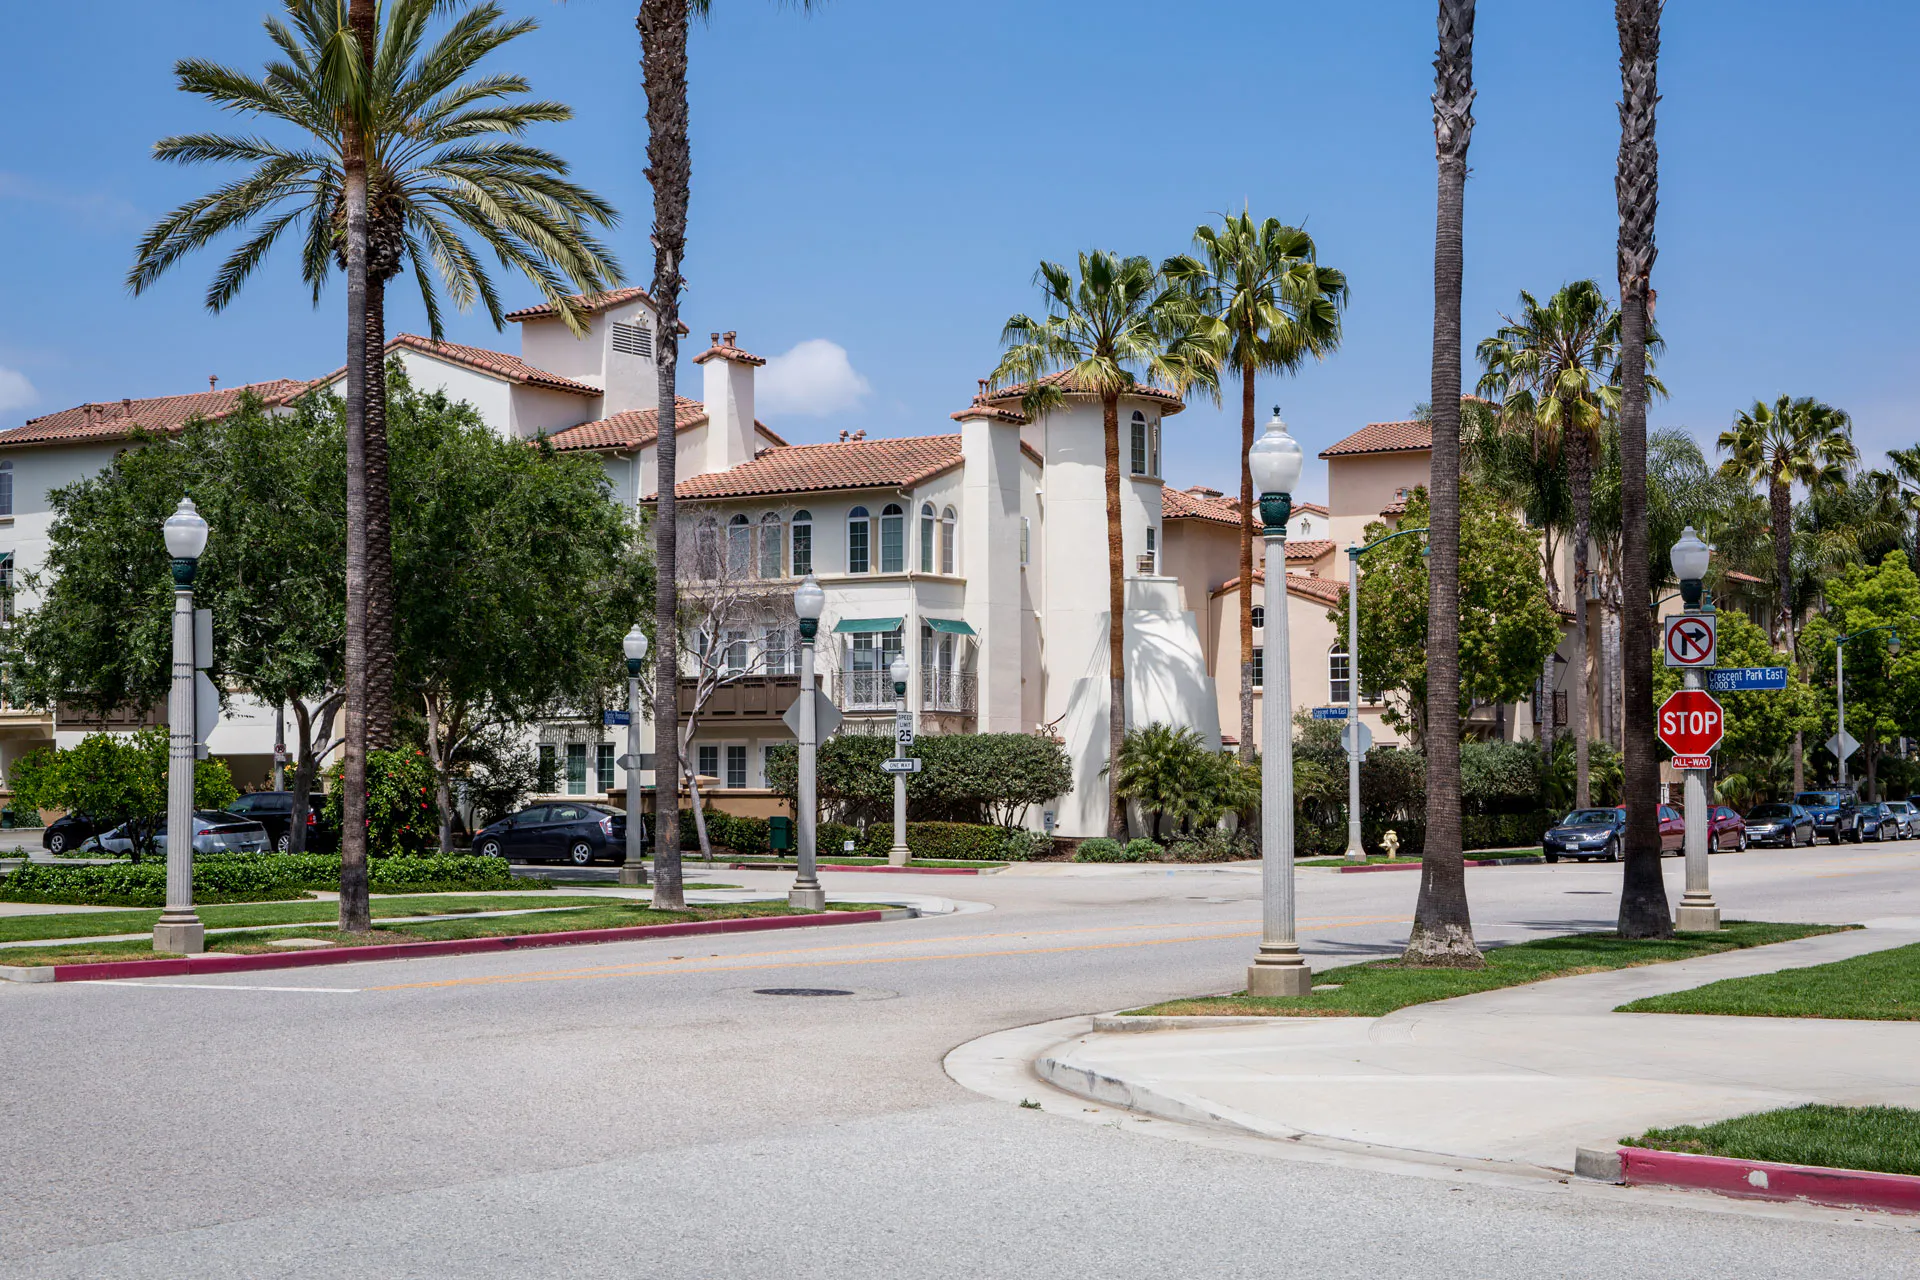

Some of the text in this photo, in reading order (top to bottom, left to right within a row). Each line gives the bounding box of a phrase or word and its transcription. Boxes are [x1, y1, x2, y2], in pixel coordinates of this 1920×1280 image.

[1709, 668, 1783, 682] Crescent Park East
[1710, 681, 1737, 689] 6000 S
[1663, 711, 1718, 735] STOP
[899, 729, 911, 742] 25
[1673, 758, 1709, 767] ALL-WAY
